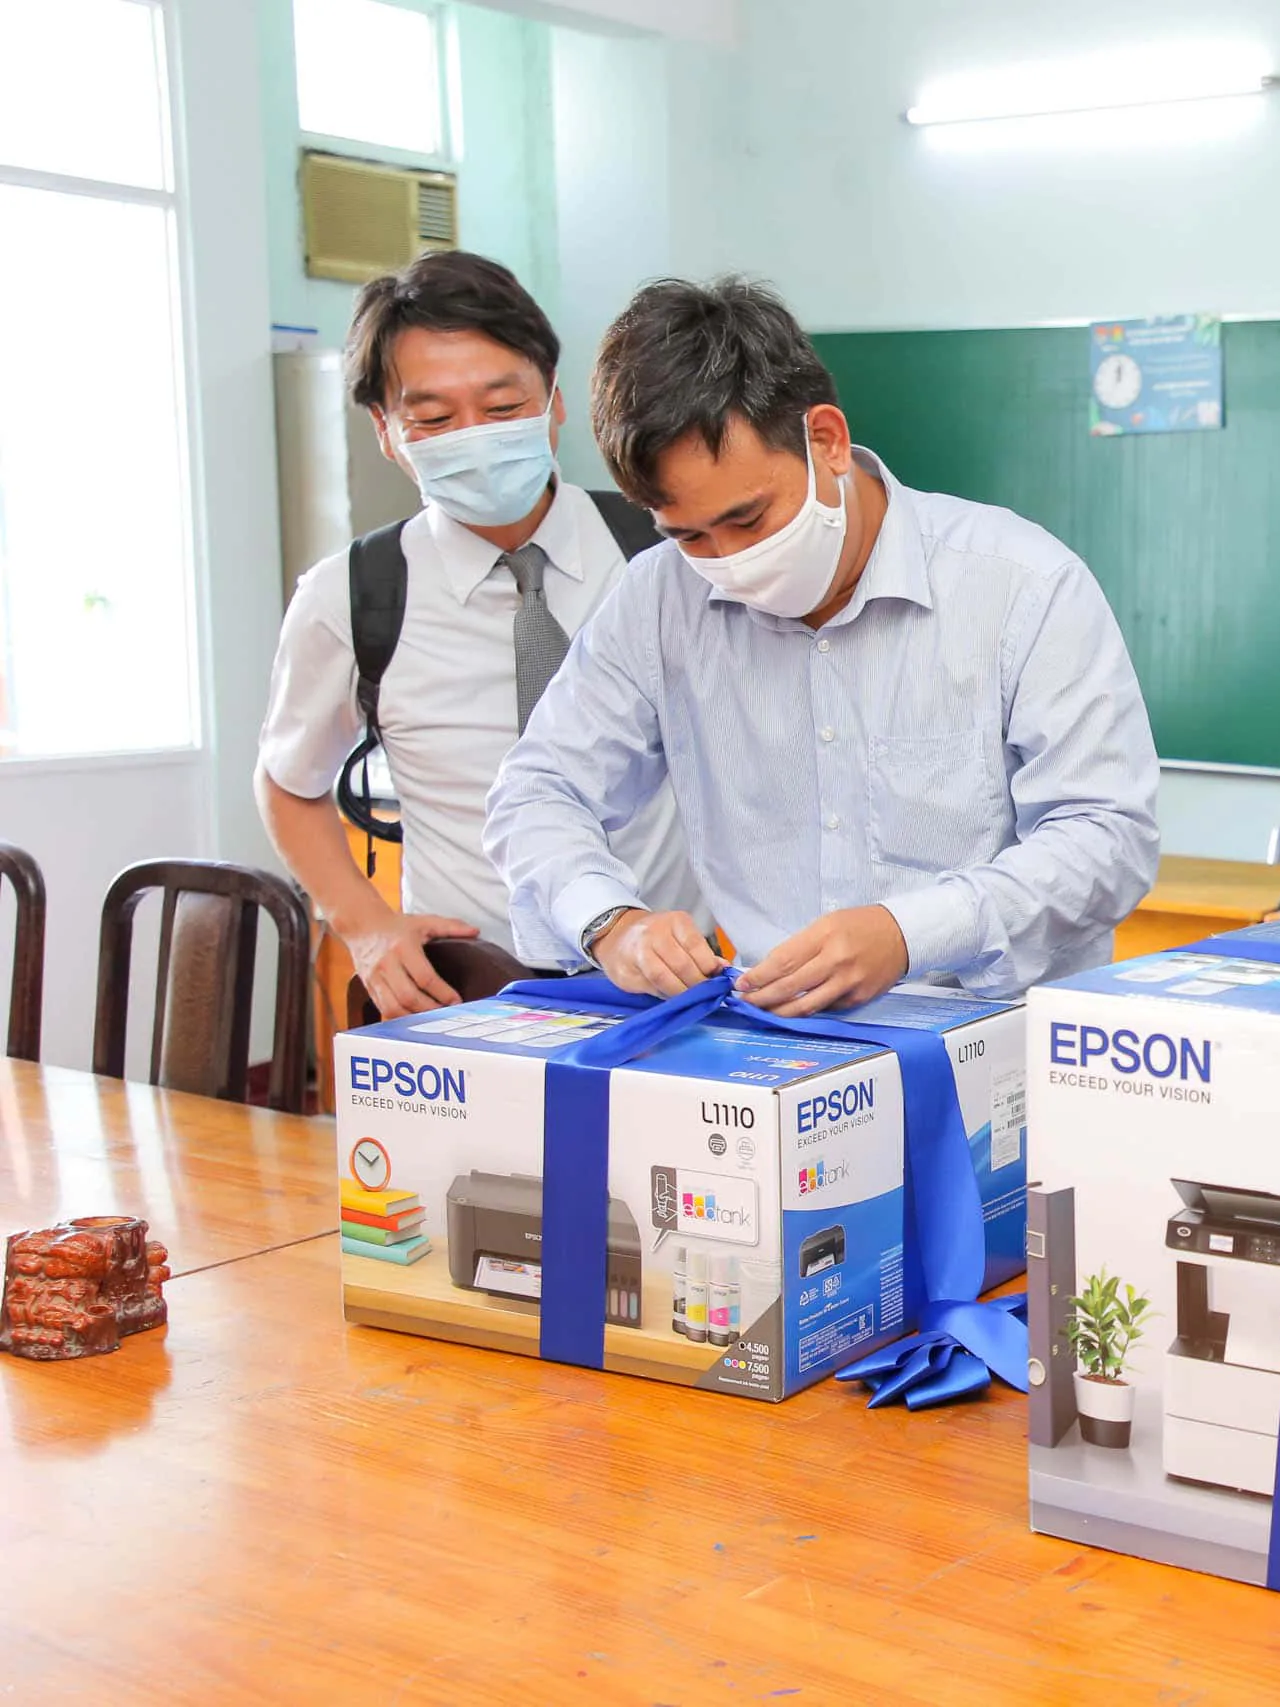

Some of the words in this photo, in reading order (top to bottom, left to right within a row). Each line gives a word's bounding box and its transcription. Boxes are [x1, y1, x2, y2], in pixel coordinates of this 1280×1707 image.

[958, 1039, 985, 1063] L1110
[1050, 1021, 1211, 1084] EPSON
[351, 1056, 466, 1104] EPSON
[1049, 1070, 1108, 1091] EXCEED
[1112, 1079, 1154, 1097] YOUR
[1160, 1085, 1211, 1105] VISION
[351, 1094, 394, 1110] EXCEED
[397, 1101, 427, 1115] YOUR
[430, 1105, 467, 1120] VISION
[702, 1101, 754, 1129] L1110
[797, 1078, 874, 1134] EPSON
[797, 1130, 828, 1149] EXCEED
[829, 1121, 849, 1137] YOUR
[850, 1112, 874, 1129] VISION
[682, 1196, 751, 1227] ecotank
